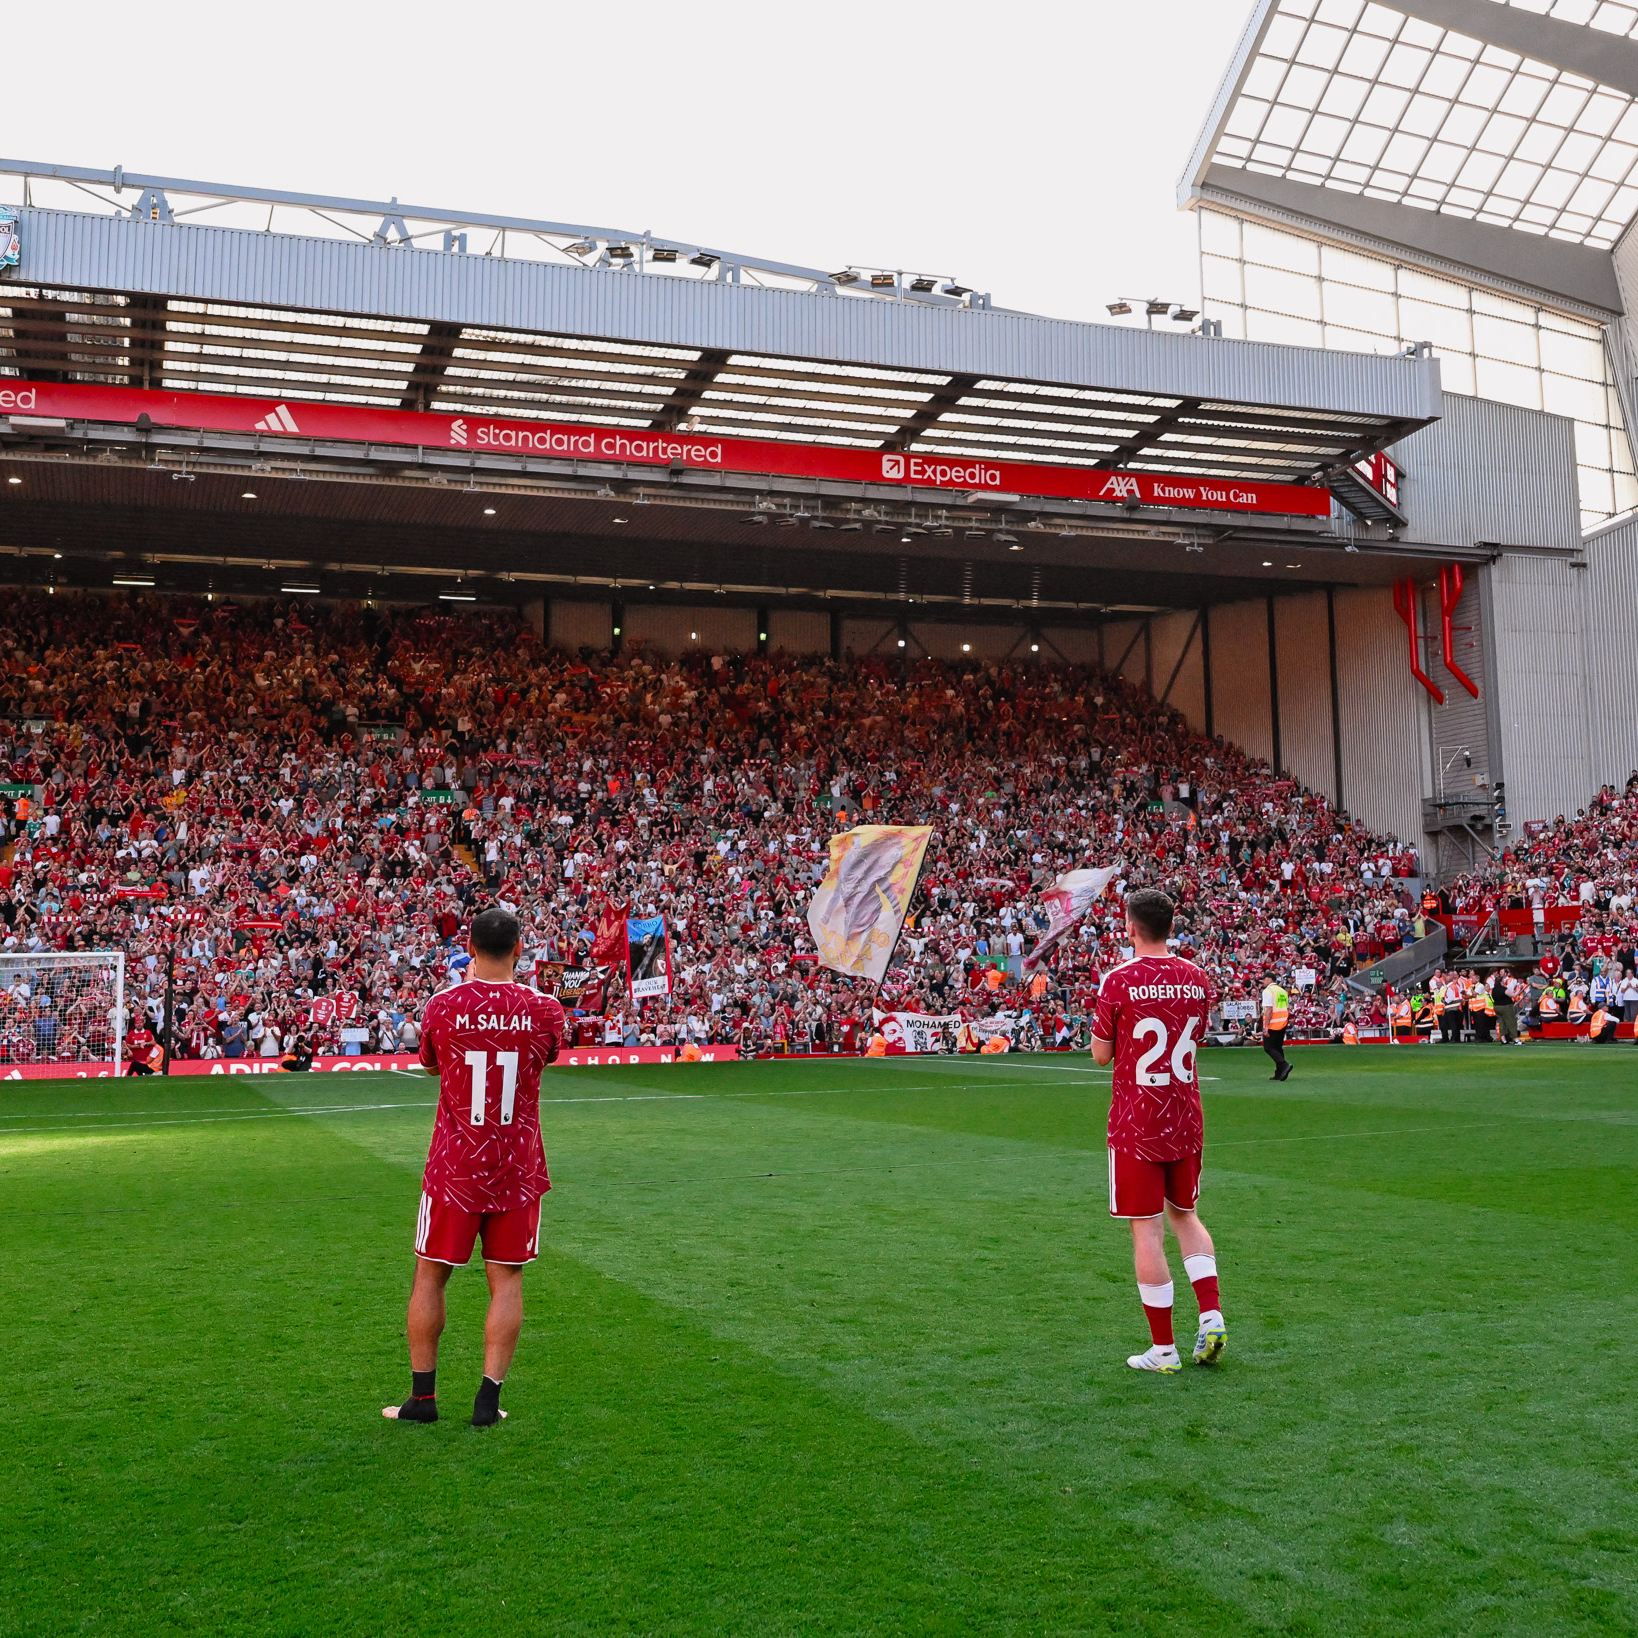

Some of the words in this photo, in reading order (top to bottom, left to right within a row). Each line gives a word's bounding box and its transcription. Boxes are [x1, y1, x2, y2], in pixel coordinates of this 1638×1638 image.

[476, 424, 595, 453] standard
[601, 434, 722, 463] chartered
[910, 458, 1000, 486] Expedia
[1099, 475, 1141, 498] AXA
[1153, 482, 1195, 500] Know
[1199, 486, 1227, 502] You
[1229, 489, 1257, 504] Can
[564, 980, 581, 989] YOU
[1128, 985, 1205, 1000] ROBERTSON
[906, 1020, 961, 1029] MOHAMED
[661, 1053, 715, 1063] NW
[1132, 1017, 1200, 1086] 26
[465, 1051, 519, 1125] 11
